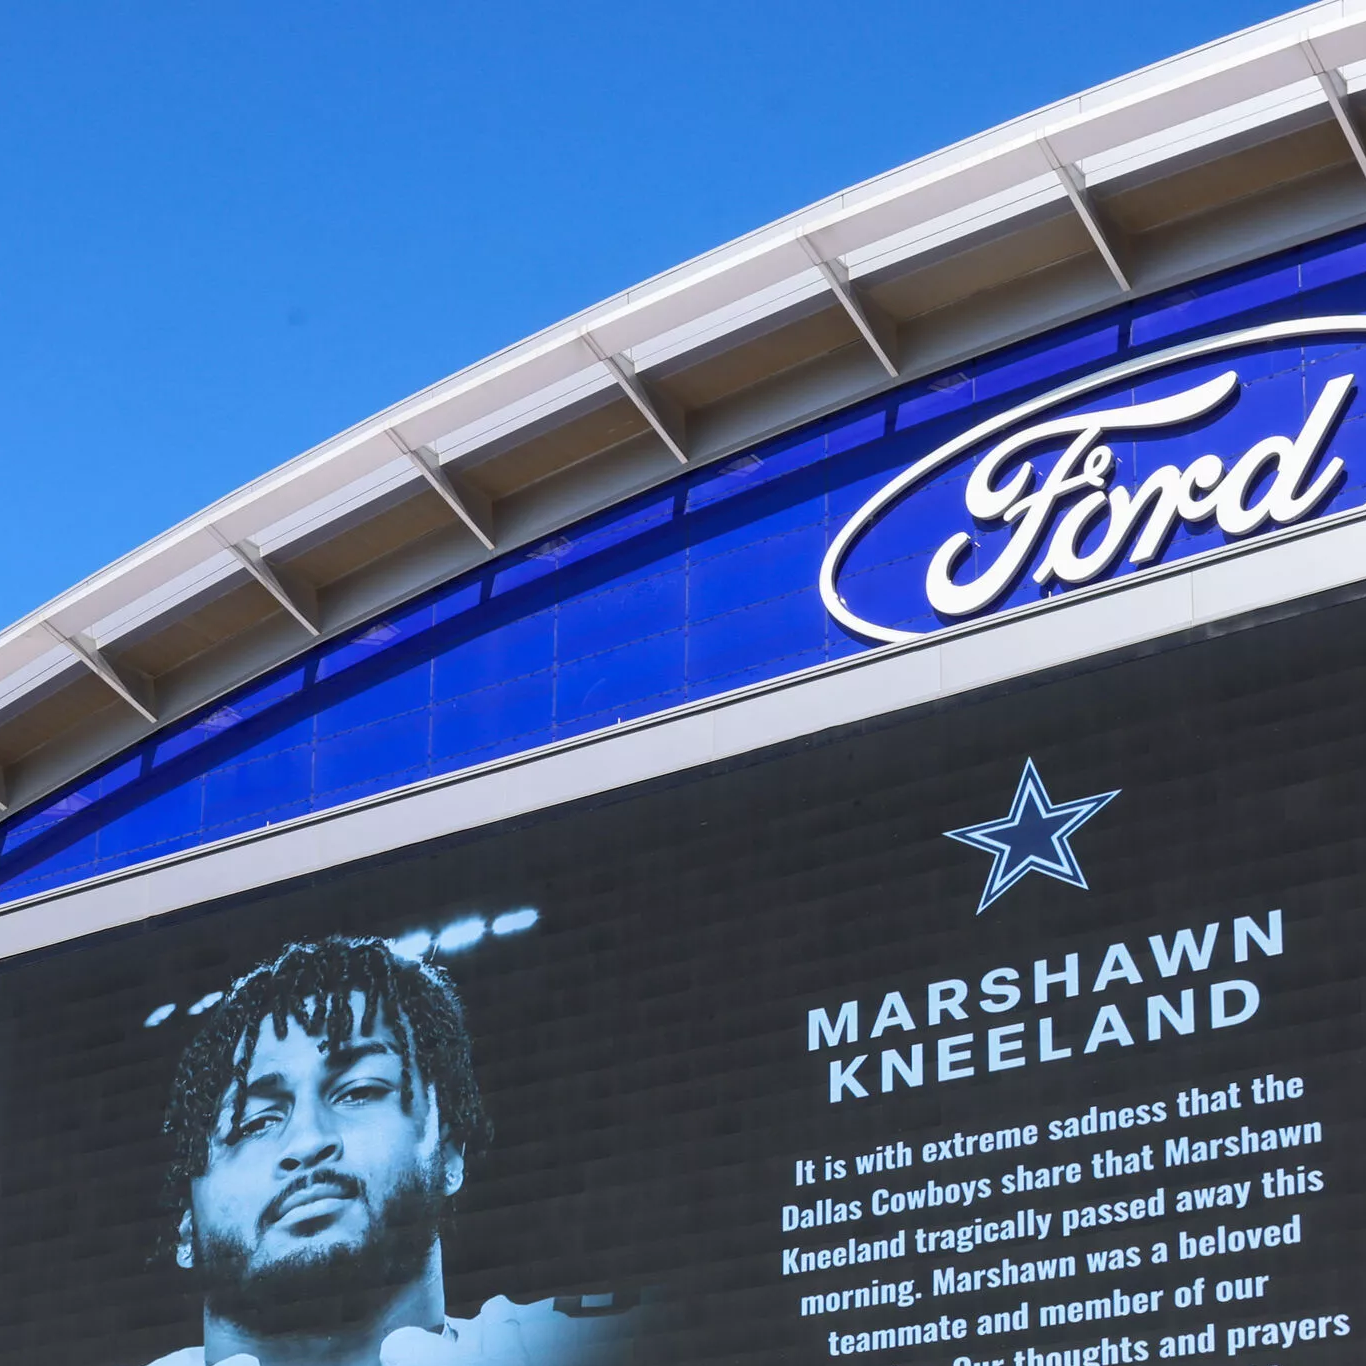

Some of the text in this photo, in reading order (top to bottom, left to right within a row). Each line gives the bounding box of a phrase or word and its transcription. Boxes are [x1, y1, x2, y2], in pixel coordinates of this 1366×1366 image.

[925, 370, 1355, 617] Ford
[809, 909, 1283, 1051] MARSHAWN
[830, 980, 1259, 1103] KNEELAND
[783, 1122, 1321, 1232] Dallas Cowboys share that Marshawn
[796, 1074, 1303, 1186] It is with extreme sadness that the
[783, 1166, 1324, 1275] Kneeland tragically passed away this
[802, 1214, 1300, 1316] morning. Marshawn was a beloved
[828, 1276, 1269, 1356] teammate and member of our
[1160, 1324, 1215, 1358] and
[1228, 1314, 1350, 1356] prayers
